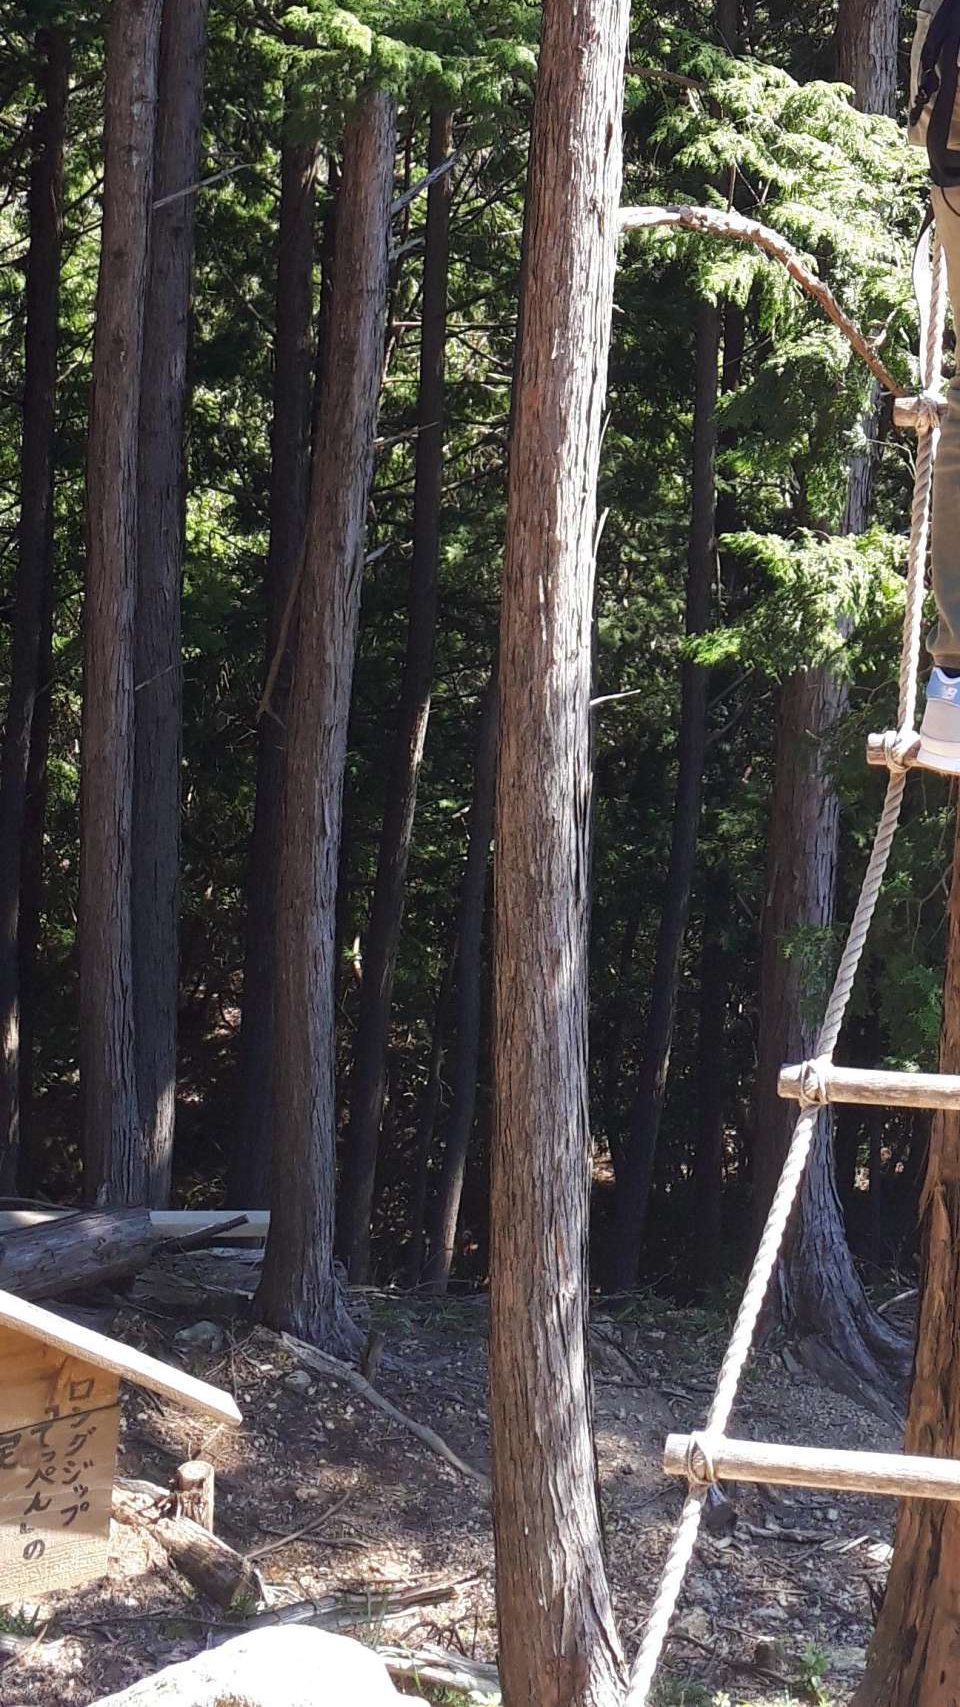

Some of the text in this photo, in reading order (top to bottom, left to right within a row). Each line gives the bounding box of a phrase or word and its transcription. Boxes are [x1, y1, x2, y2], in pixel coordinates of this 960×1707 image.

[61, 1378, 96, 1526] ロングジップ
